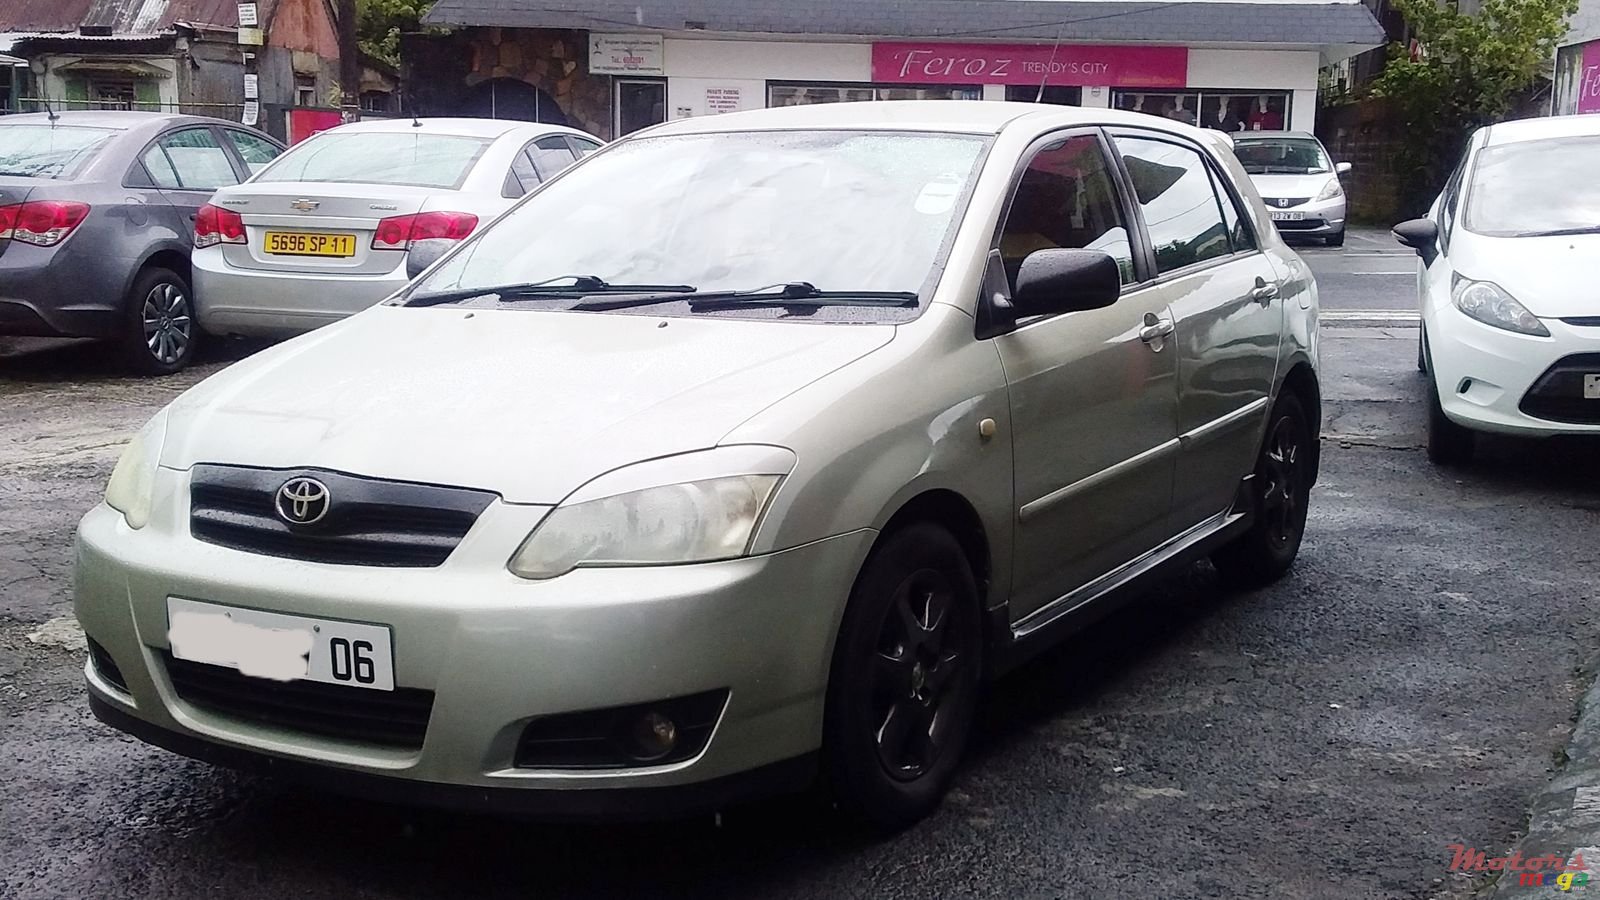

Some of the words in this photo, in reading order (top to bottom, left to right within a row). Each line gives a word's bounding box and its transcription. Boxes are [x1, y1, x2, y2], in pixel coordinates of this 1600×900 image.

[894, 50, 1012, 77] Feroz
[1022, 61, 1078, 74] TRENDY'S
[1081, 62, 1108, 74] CITY
[271, 235, 305, 251] 5696
[310, 236, 327, 252] SP
[330, 637, 375, 684] 06
